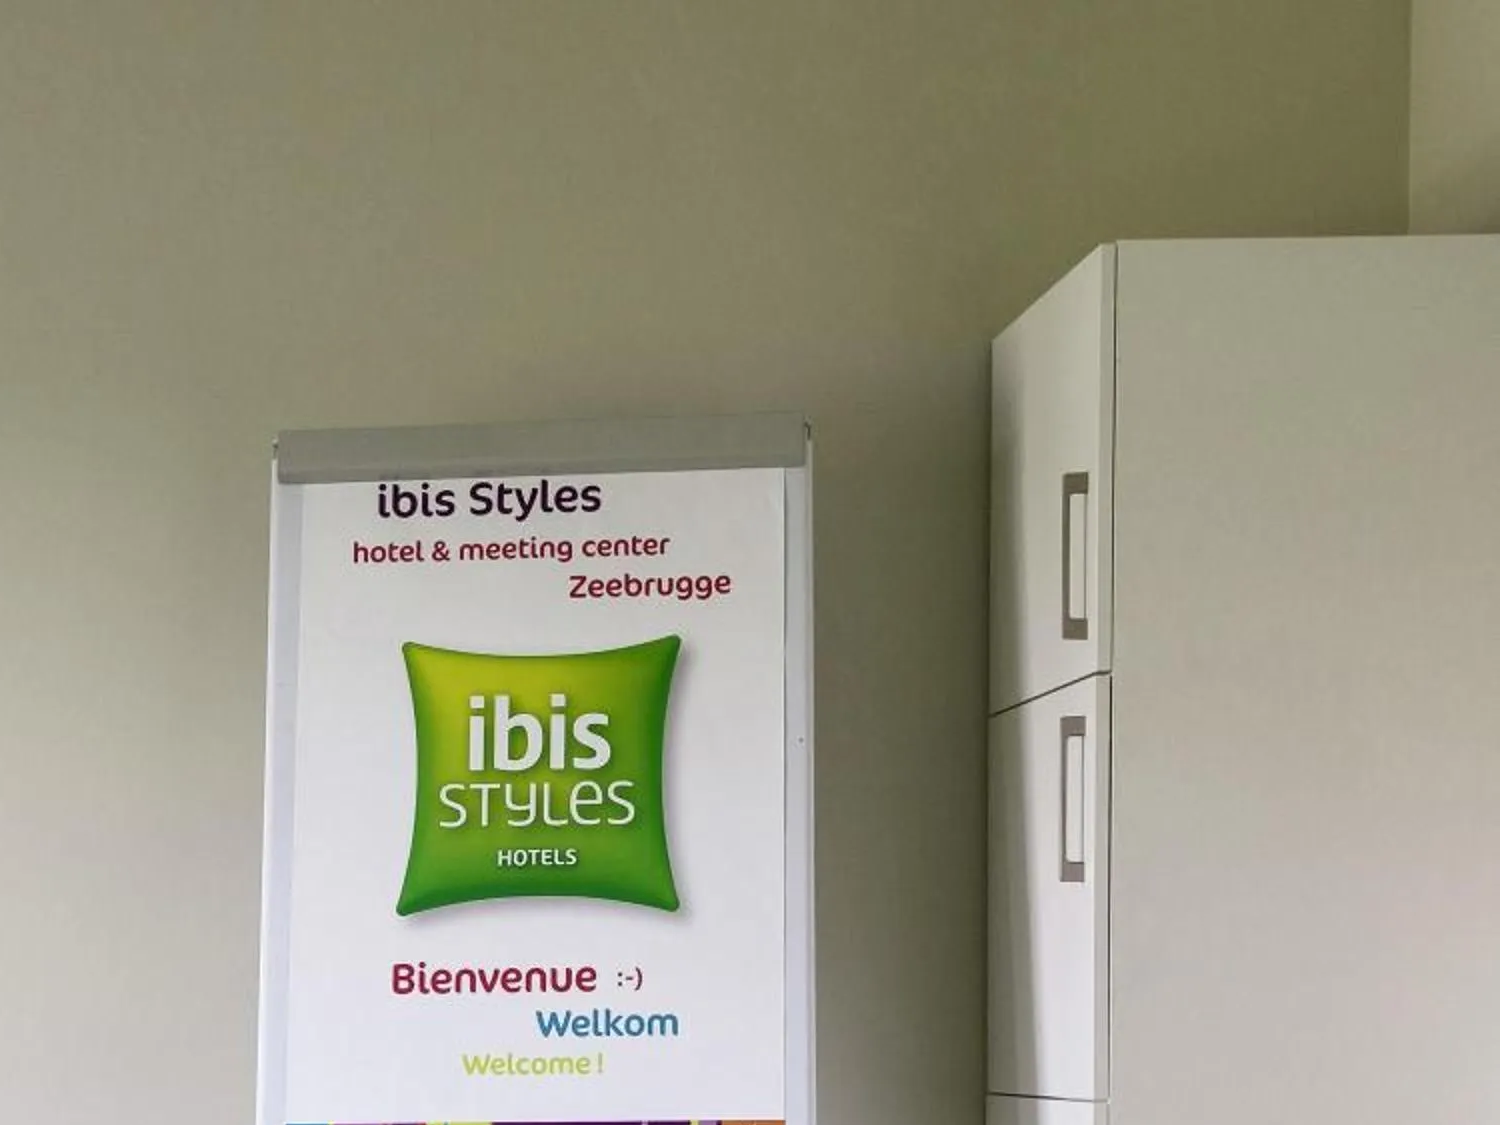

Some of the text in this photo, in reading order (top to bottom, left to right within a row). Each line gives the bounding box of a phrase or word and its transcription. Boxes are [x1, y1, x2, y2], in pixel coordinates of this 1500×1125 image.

[377, 480, 602, 522] ibis Styles
[353, 536, 670, 564] hotel & meeting center
[569, 574, 732, 600] Zeebrugge
[469, 694, 611, 772] ibis
[497, 849, 577, 867] HOTELS
[391, 962, 597, 995] Bienvenue
[536, 1008, 679, 1038] Welkom
